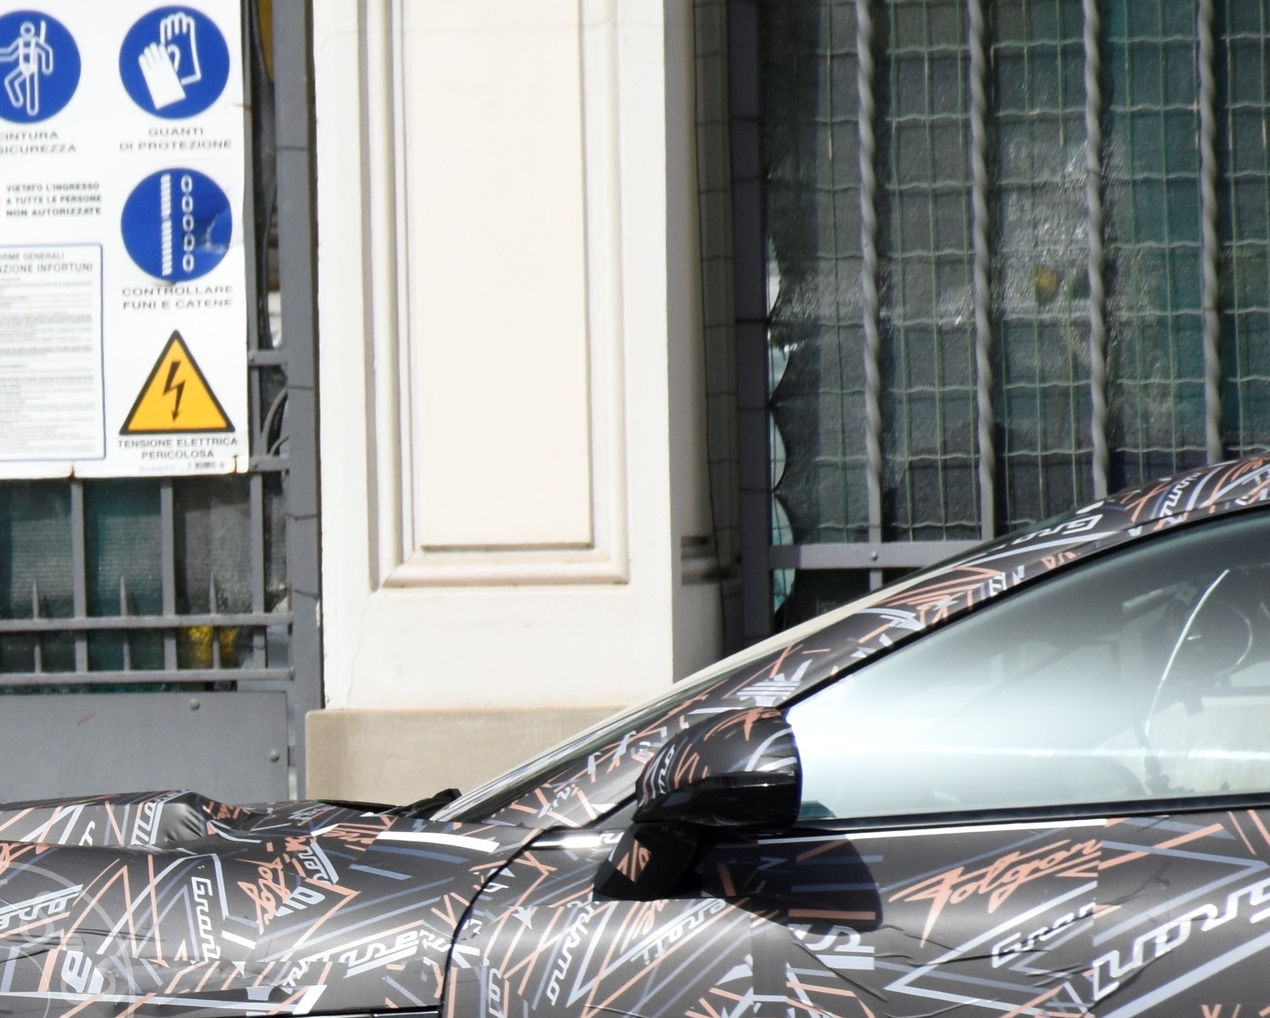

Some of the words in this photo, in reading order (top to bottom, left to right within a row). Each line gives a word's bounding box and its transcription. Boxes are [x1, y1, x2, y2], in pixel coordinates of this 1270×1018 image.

[148, 127, 204, 137] GUANTI
[119, 141, 133, 151] DI
[138, 139, 233, 151] PROTEZIONE
[6, 183, 42, 192] VIETATO
[14, 195, 42, 205] TUTTE
[60, 195, 101, 204] PERSONE
[6, 208, 28, 217] NON
[31, 207, 101, 217] AUTORIZZATE
[37, 262, 93, 273] INFORTUNI
[122, 285, 233, 297] CONTROLLARE
[123, 300, 156, 310] FUNI
[161, 300, 170, 309] E
[175, 298, 233, 309] CATENE
[118, 439, 172, 448] TENSIONE
[176, 437, 238, 447] ELETTRICA
[141, 450, 214, 460] PERICOLOSA
